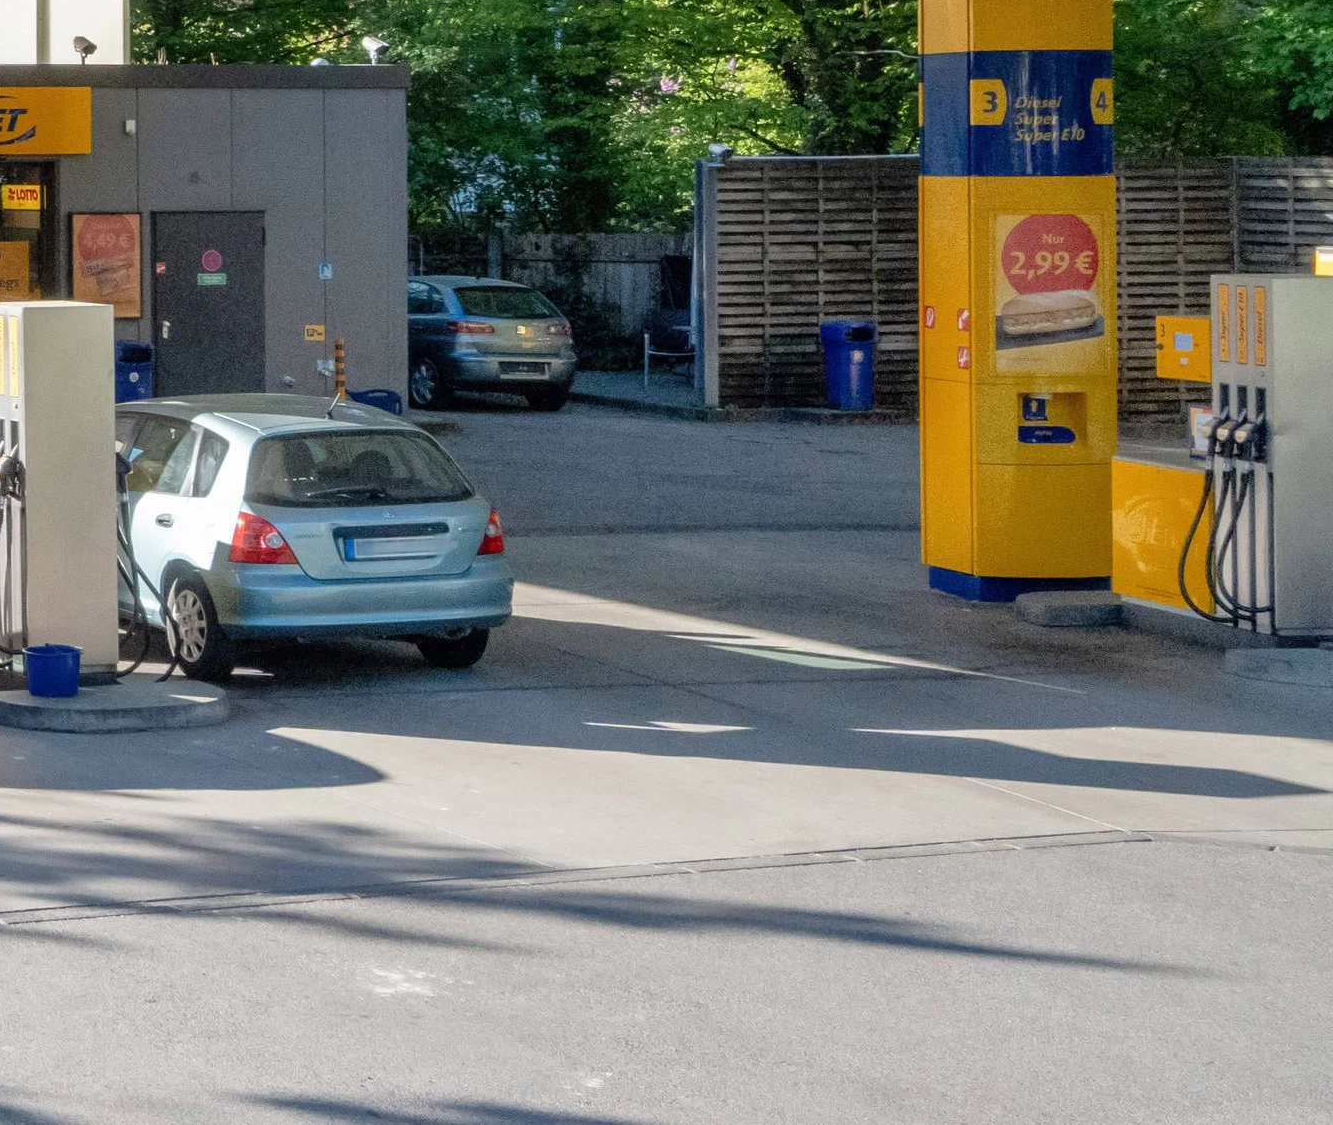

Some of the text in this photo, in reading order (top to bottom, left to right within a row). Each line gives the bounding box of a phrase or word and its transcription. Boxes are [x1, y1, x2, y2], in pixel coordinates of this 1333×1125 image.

[983, 91, 997, 113] 3
[1014, 95, 1063, 108] Diesel
[1095, 91, 1108, 112] 4
[1014, 113, 1059, 128] Super
[1014, 127, 1085, 144] Super E10
[16, 187, 38, 201] LOTTO
[1042, 233, 1065, 244] Nur
